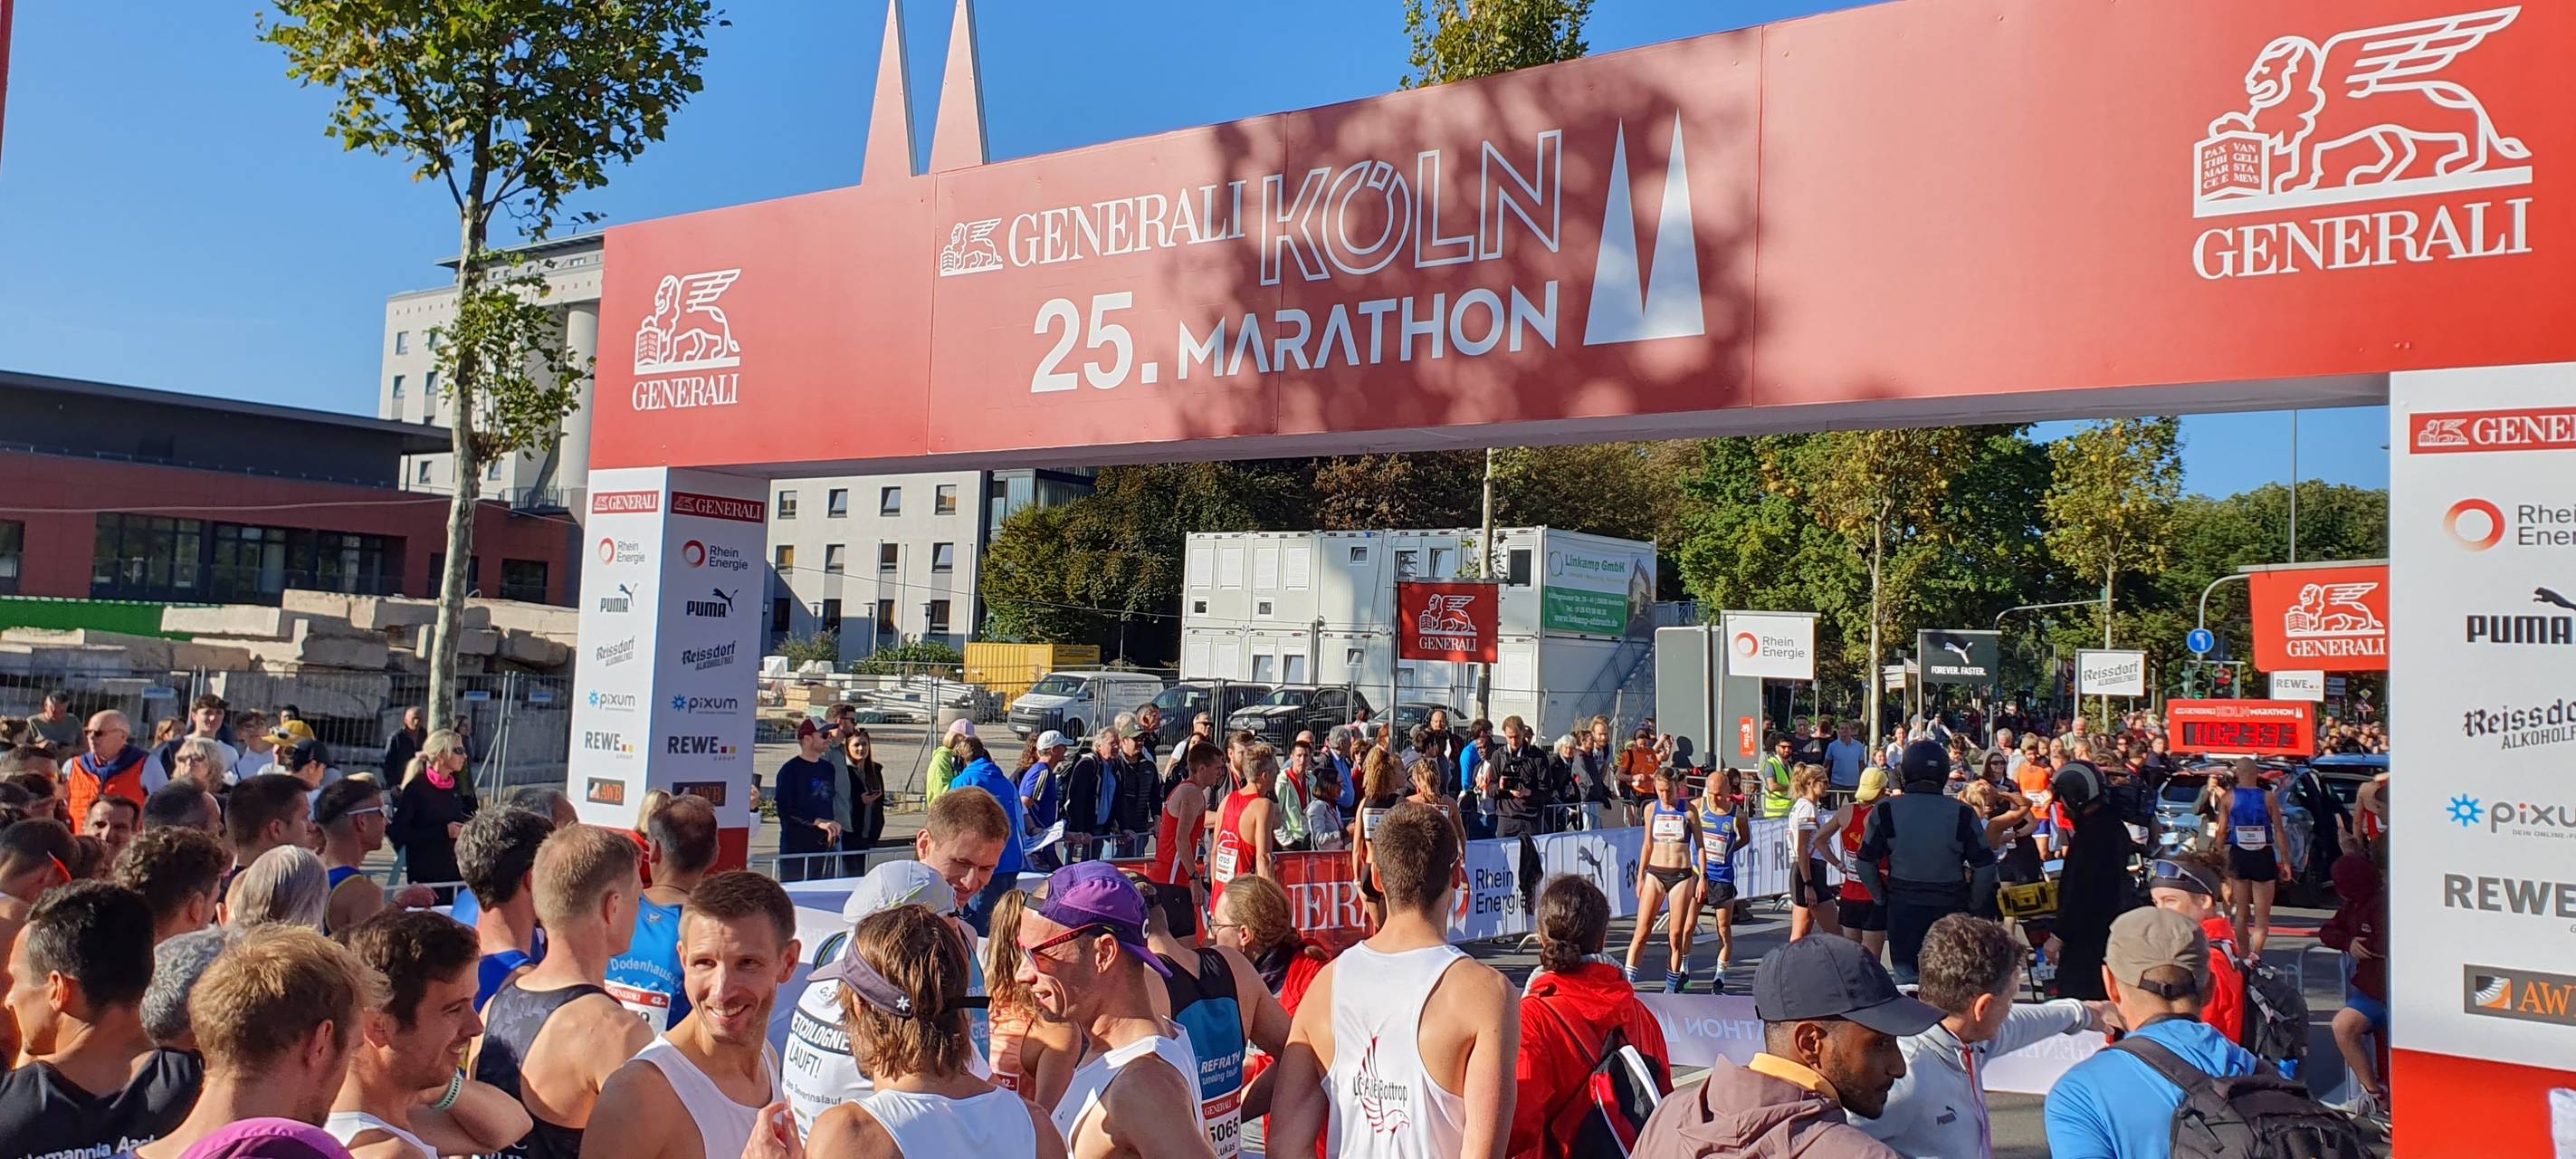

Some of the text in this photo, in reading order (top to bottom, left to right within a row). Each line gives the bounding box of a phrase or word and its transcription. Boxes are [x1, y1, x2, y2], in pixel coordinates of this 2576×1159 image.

[1007, 179, 1246, 268] GENERALI
[2193, 197, 2533, 280] GENERALI
[1030, 280, 1558, 394] 25. MARATHON
[632, 373, 739, 411] GENERALI
[2472, 414, 2576, 445] GENE
[608, 494, 657, 511] GENERALI
[695, 499, 762, 520] GENERALI
[617, 540, 639, 551] Rhein
[709, 545, 739, 559] Rhein
[616, 551, 645, 564] Energie
[709, 556, 749, 571] Energie
[1565, 553, 1599, 572] Linkamp
[600, 597, 629, 613] PUMA
[686, 599, 728, 618] PUMA
[2466, 615, 2573, 645] PUMA
[1419, 636, 1477, 652] GENERALI
[1762, 636, 1794, 647] Rhein
[2286, 637, 2387, 657] GENERALI
[682, 640, 737, 666] Reissdorf
[1762, 647, 1805, 659] Energie
[2084, 661, 2138, 681] Reissdorf
[2275, 679, 2308, 689] REWE
[600, 693, 635, 709] pixum
[689, 696, 738, 714] pixum
[2250, 709, 2295, 717] MARATHON
[585, 731, 621, 752] REWE
[667, 735, 719, 754] REWE
[601, 783, 622, 801] AWB
[1475, 867, 1514, 890] Rhein
[1475, 889, 1527, 915] Energie
[2518, 980, 2576, 1017] AW
[791, 1014, 851, 1052] ETCOLOGNE
[788, 1040, 823, 1079] LÄUFT!
